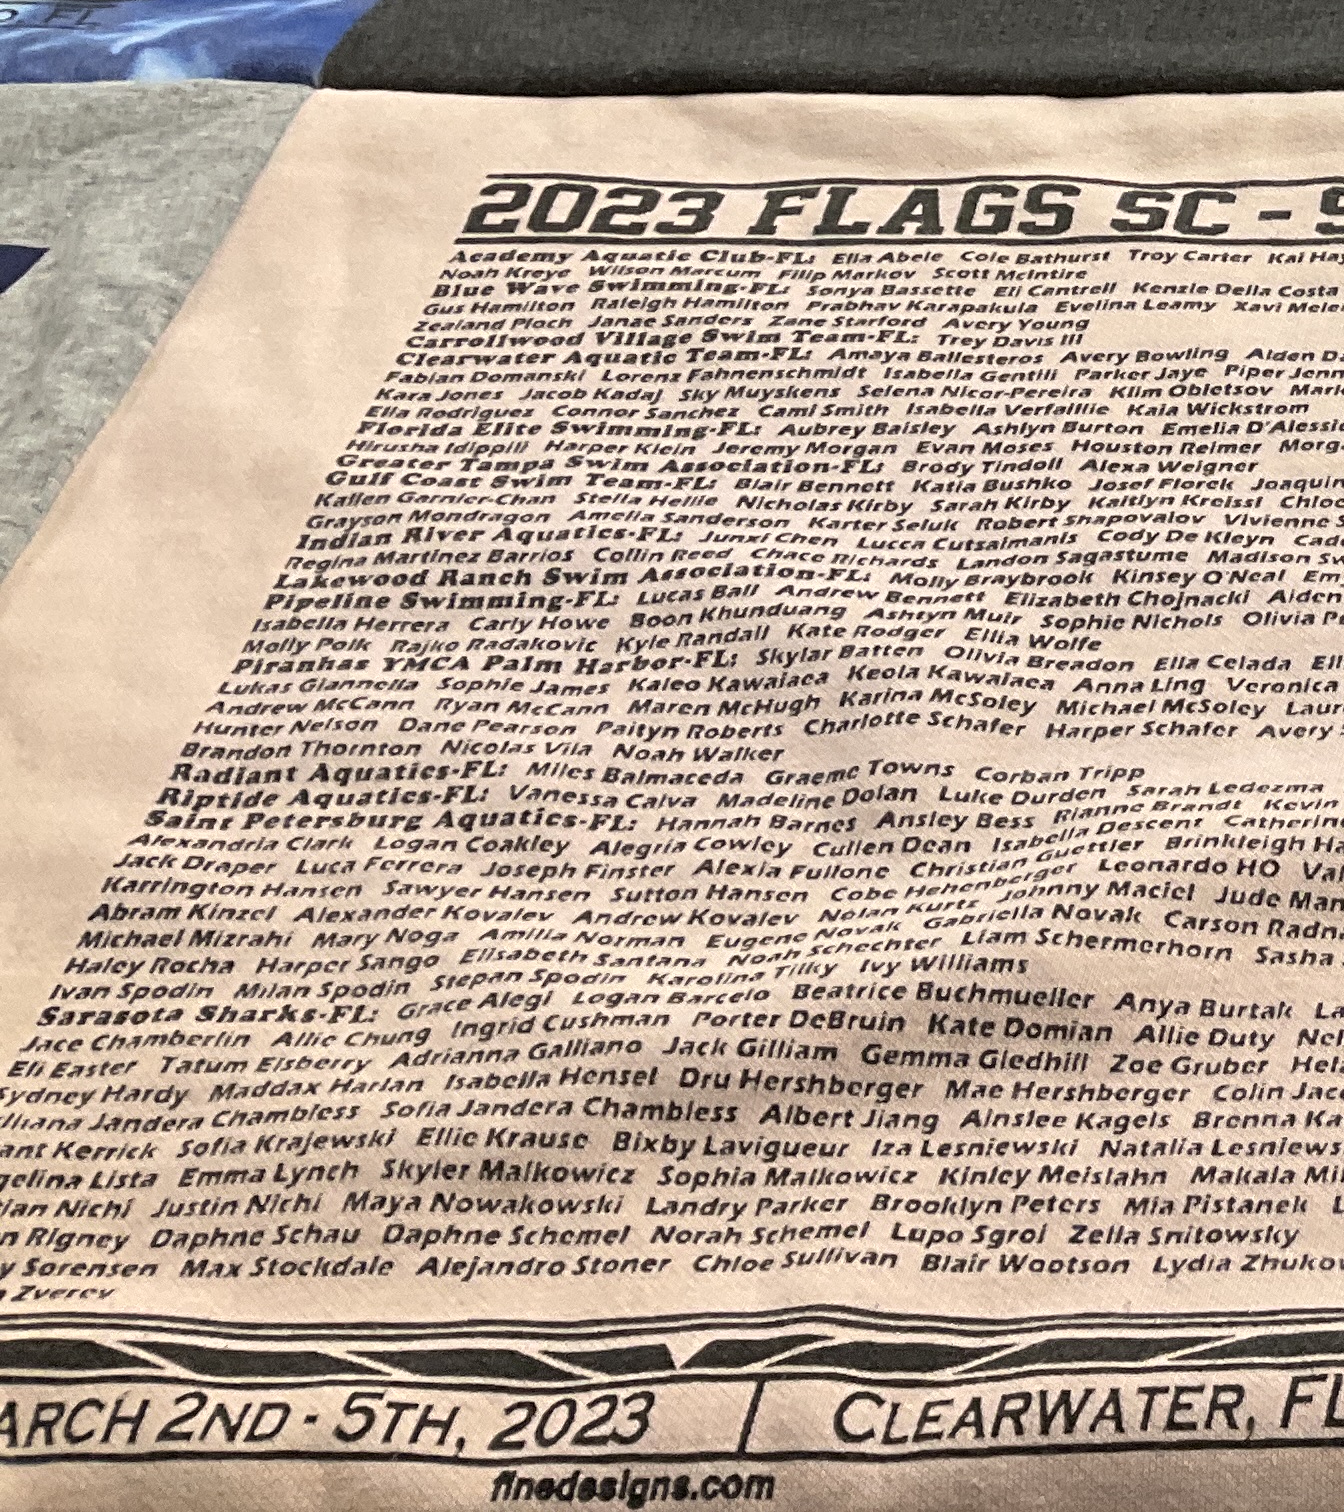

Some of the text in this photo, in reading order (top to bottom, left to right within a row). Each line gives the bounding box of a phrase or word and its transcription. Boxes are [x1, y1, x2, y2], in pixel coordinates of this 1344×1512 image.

[460, 182, 725, 237] 2023
[746, 184, 1082, 238] FLAGS
[1110, 188, 1237, 236] SC
[1258, 210, 1293, 222] -
[449, 250, 815, 264] Academy Aquatic Club-FL:
[406, 329, 919, 348] Carrollwood Village Swim Team-FL:
[397, 353, 556, 366] Clearwater
[563, 351, 677, 367] Aquatic
[687, 347, 812, 363] Team-FL:
[296, 525, 683, 550] Indian River Aquatics-FL:
[273, 564, 870, 589] Lakewood Ranch Swim Association-FL:
[170, 760, 1144, 787] Radiant Aquatics-FL: Corban Tripp
[145, 806, 637, 832] Saint Petersburg Aquatics-FL:
[77, 929, 292, 948] Michael Mizrahi
[860, 954, 1028, 978] Ivy Williams
[342, 1190, 1100, 1219] Maya Nowakowski Brooklyn Peters
[180, 1253, 1130, 1281] Max Stockdale Alejandro Stoner Blair Wootson
[155, 1389, 295, 1446] 2ND
[332, 1390, 474, 1460] 5TH,
[485, 1389, 658, 1449] 2023
[834, 1383, 1258, 1447] CLEARWATER,
[490, 1468, 776, 1506] finedesigns.com
